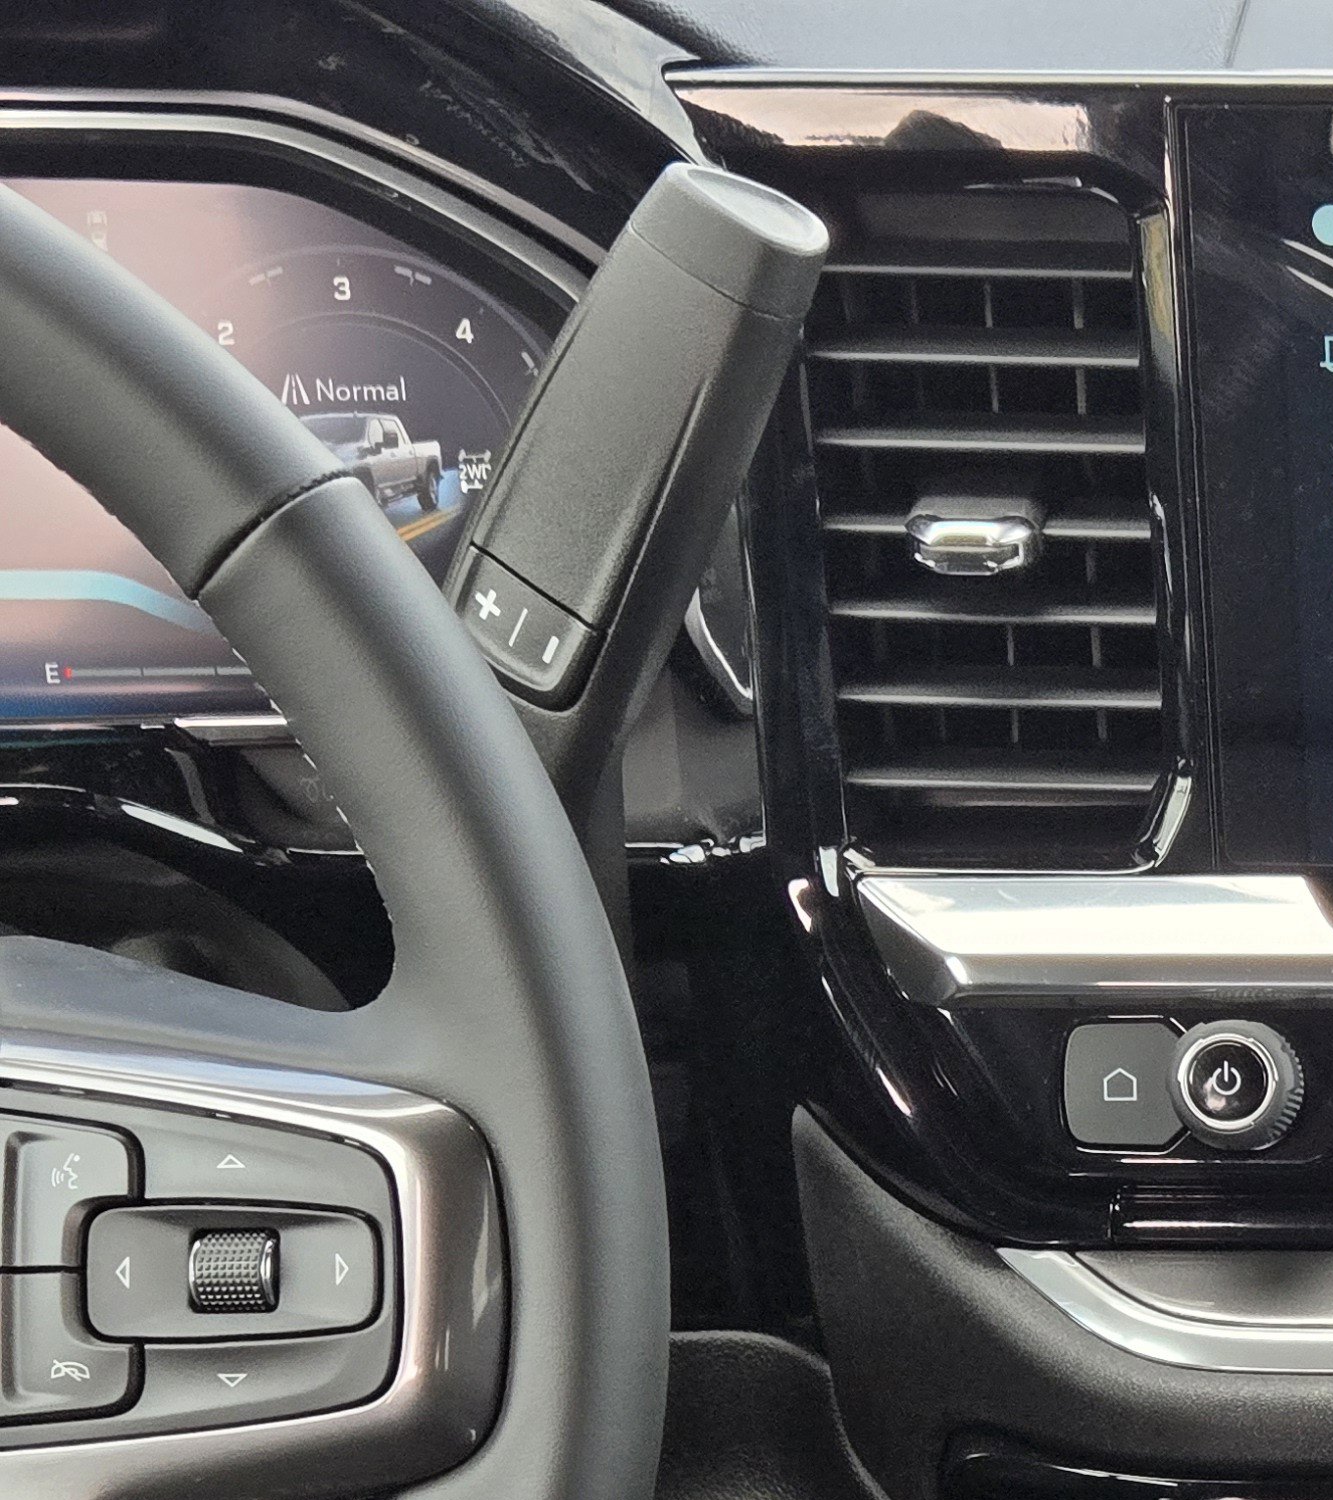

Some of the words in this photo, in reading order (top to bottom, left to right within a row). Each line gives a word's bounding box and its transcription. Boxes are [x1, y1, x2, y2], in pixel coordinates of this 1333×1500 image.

[332, 276, 351, 302] 3
[216, 323, 235, 346] 2
[455, 318, 474, 343] 4
[315, 377, 407, 403] Normal
[46, 662, 60, 684] E
